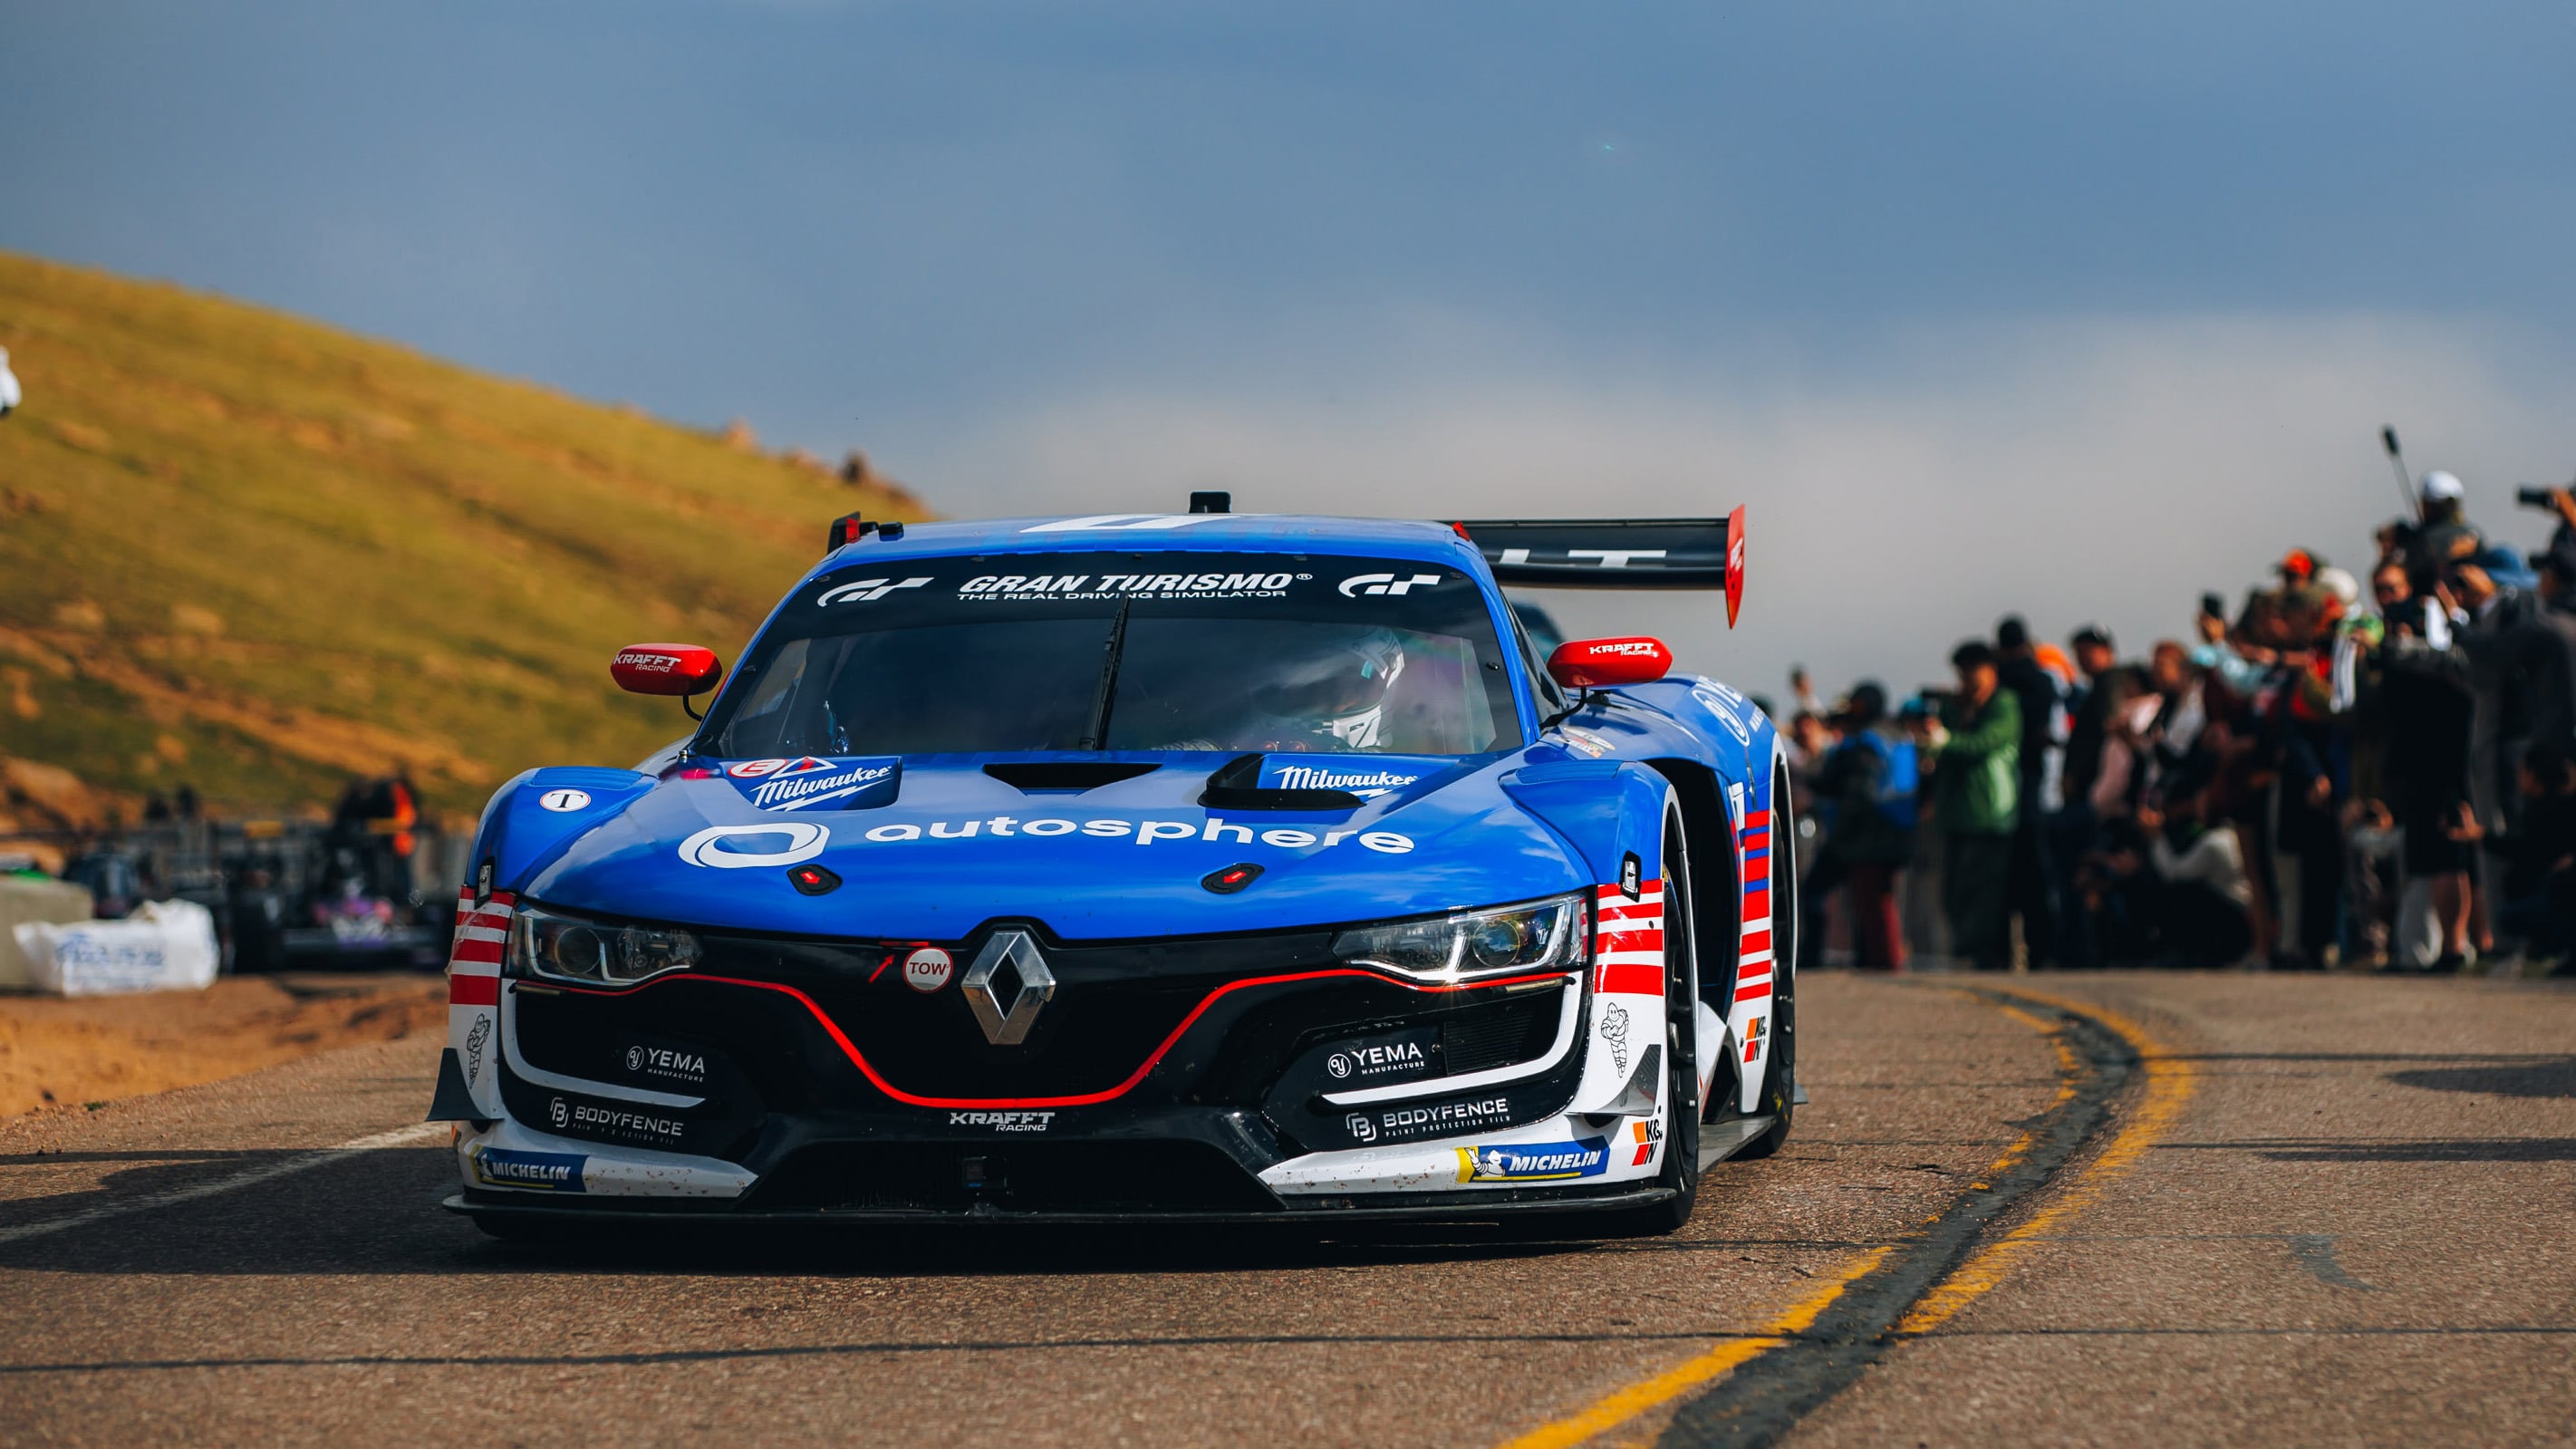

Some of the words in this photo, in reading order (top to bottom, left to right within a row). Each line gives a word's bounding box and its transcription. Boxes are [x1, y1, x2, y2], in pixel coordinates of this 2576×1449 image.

[959, 575, 1090, 593] GRAN
[1160, 590, 1287, 599] SIMULATOR
[1588, 642, 1655, 654] KRAFFT
[613, 653, 681, 667] KRAFFT
[635, 663, 671, 673] RACING
[748, 766, 890, 807] Milwaukee
[1271, 765, 1415, 790] Milwaukee
[550, 793, 584, 808] T
[863, 816, 1415, 855] autosphere
[909, 961, 948, 976] TOW
[647, 1048, 705, 1074] YEMA
[1351, 1042, 1423, 1067] YEMA
[647, 1067, 704, 1083] MANUFACTURE
[1361, 1060, 1425, 1076] MANUFACTURE
[574, 1106, 684, 1136] BODYFENCE
[950, 1111, 1056, 1125] KRAFFT
[1383, 1097, 1510, 1128] BODYFENCE
[995, 1124, 1047, 1132] RACING
[1385, 1127, 1414, 1137] PAINT
[1422, 1118, 1483, 1133] PROTECTION
[1508, 1149, 1603, 1172] MICHELIN
[492, 1162, 572, 1181] MICHELIN
